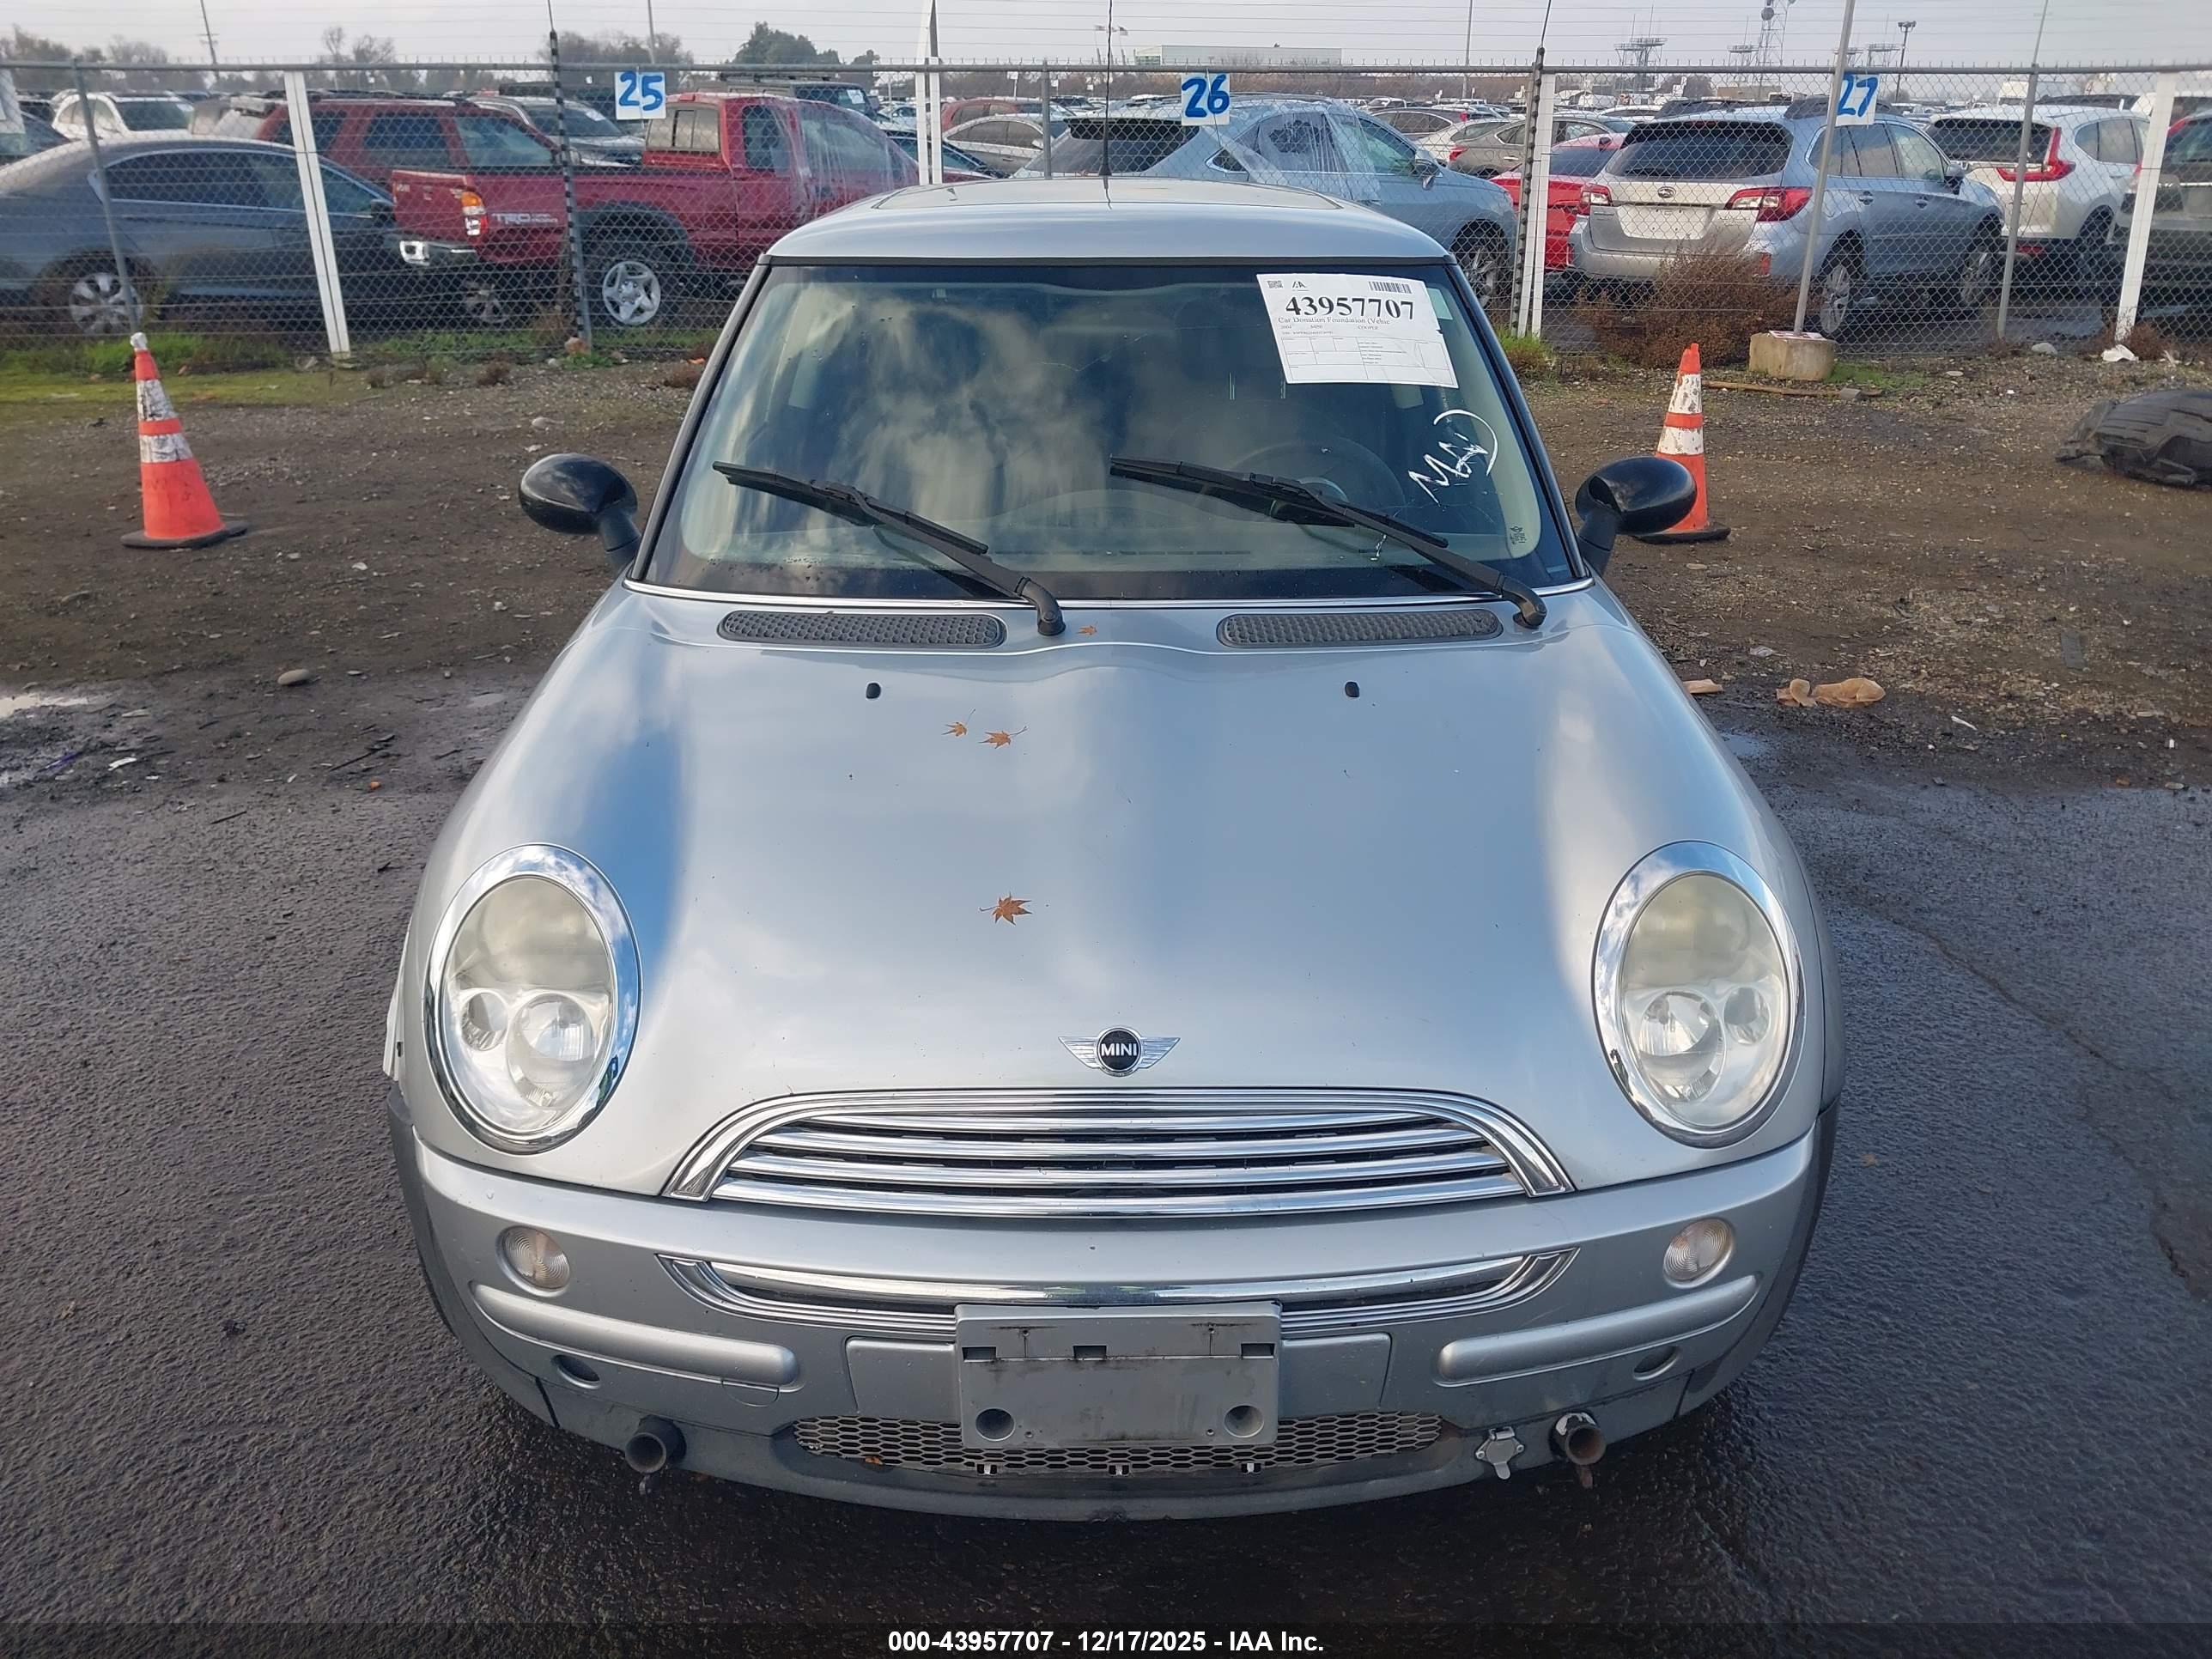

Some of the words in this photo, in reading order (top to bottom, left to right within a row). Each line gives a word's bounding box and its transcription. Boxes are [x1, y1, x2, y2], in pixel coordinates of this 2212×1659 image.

[619, 71, 664, 112] 25
[1182, 74, 1231, 118] 26
[1837, 75, 1878, 117] 27
[1285, 296, 1414, 320] 43957707
[1101, 1042, 1138, 1057] MINI
